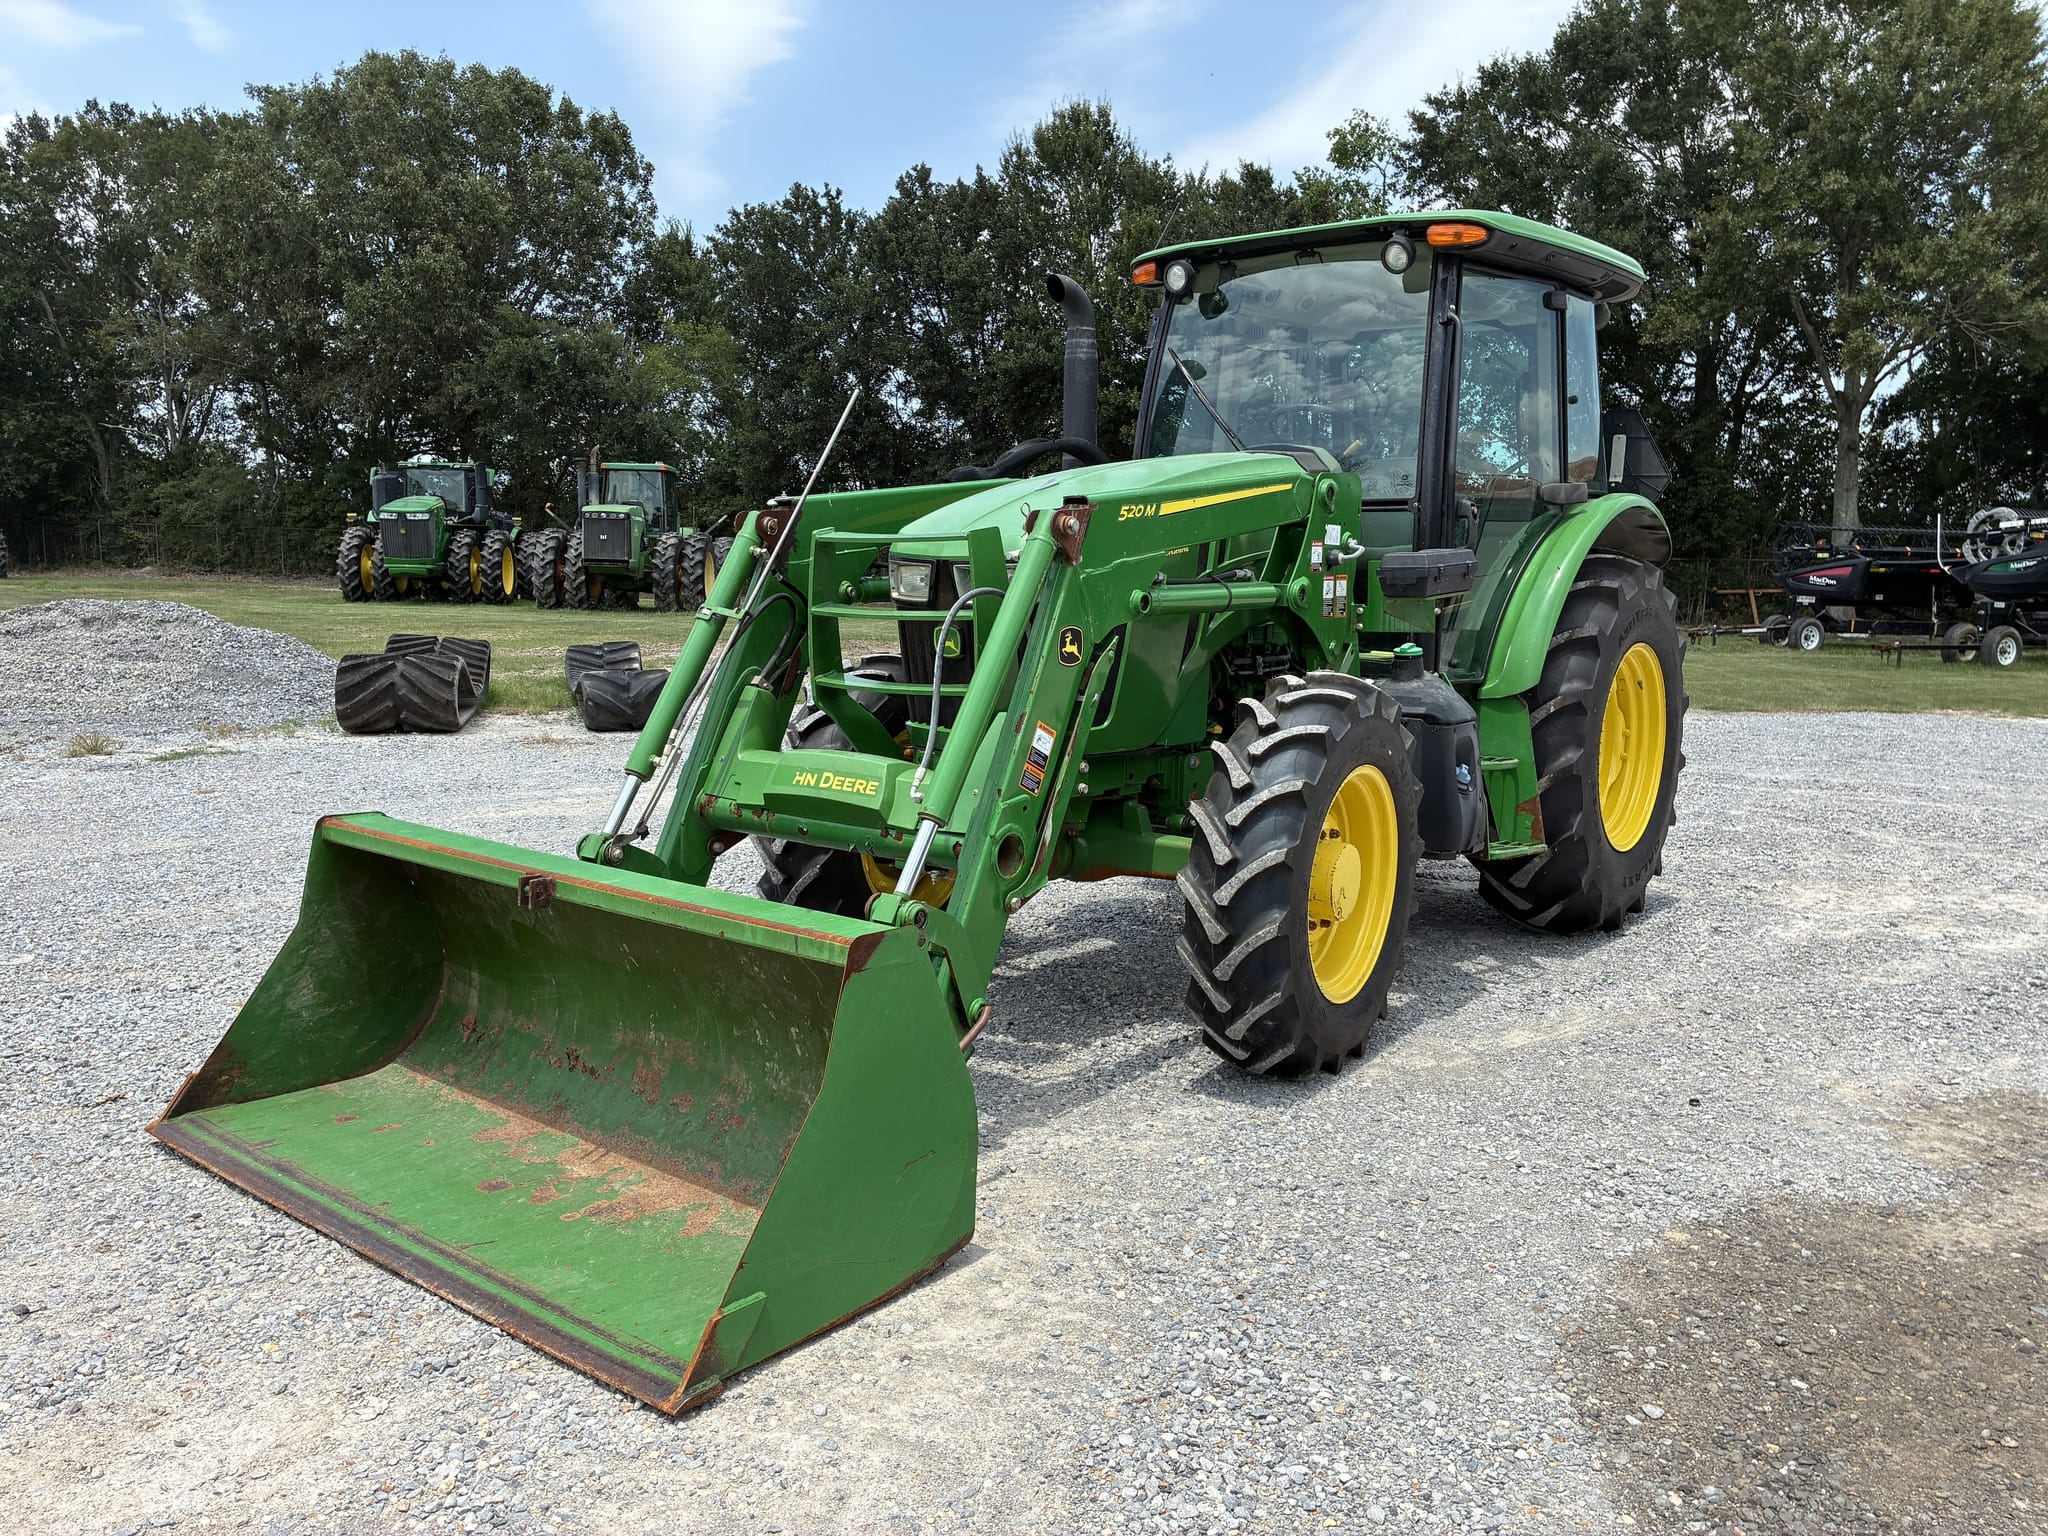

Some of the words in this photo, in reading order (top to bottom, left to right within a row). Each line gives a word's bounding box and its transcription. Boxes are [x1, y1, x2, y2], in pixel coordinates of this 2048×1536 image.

[1118, 505, 1145, 521] 520
[1145, 503, 1157, 517] M
[818, 772, 880, 796] DEERE
